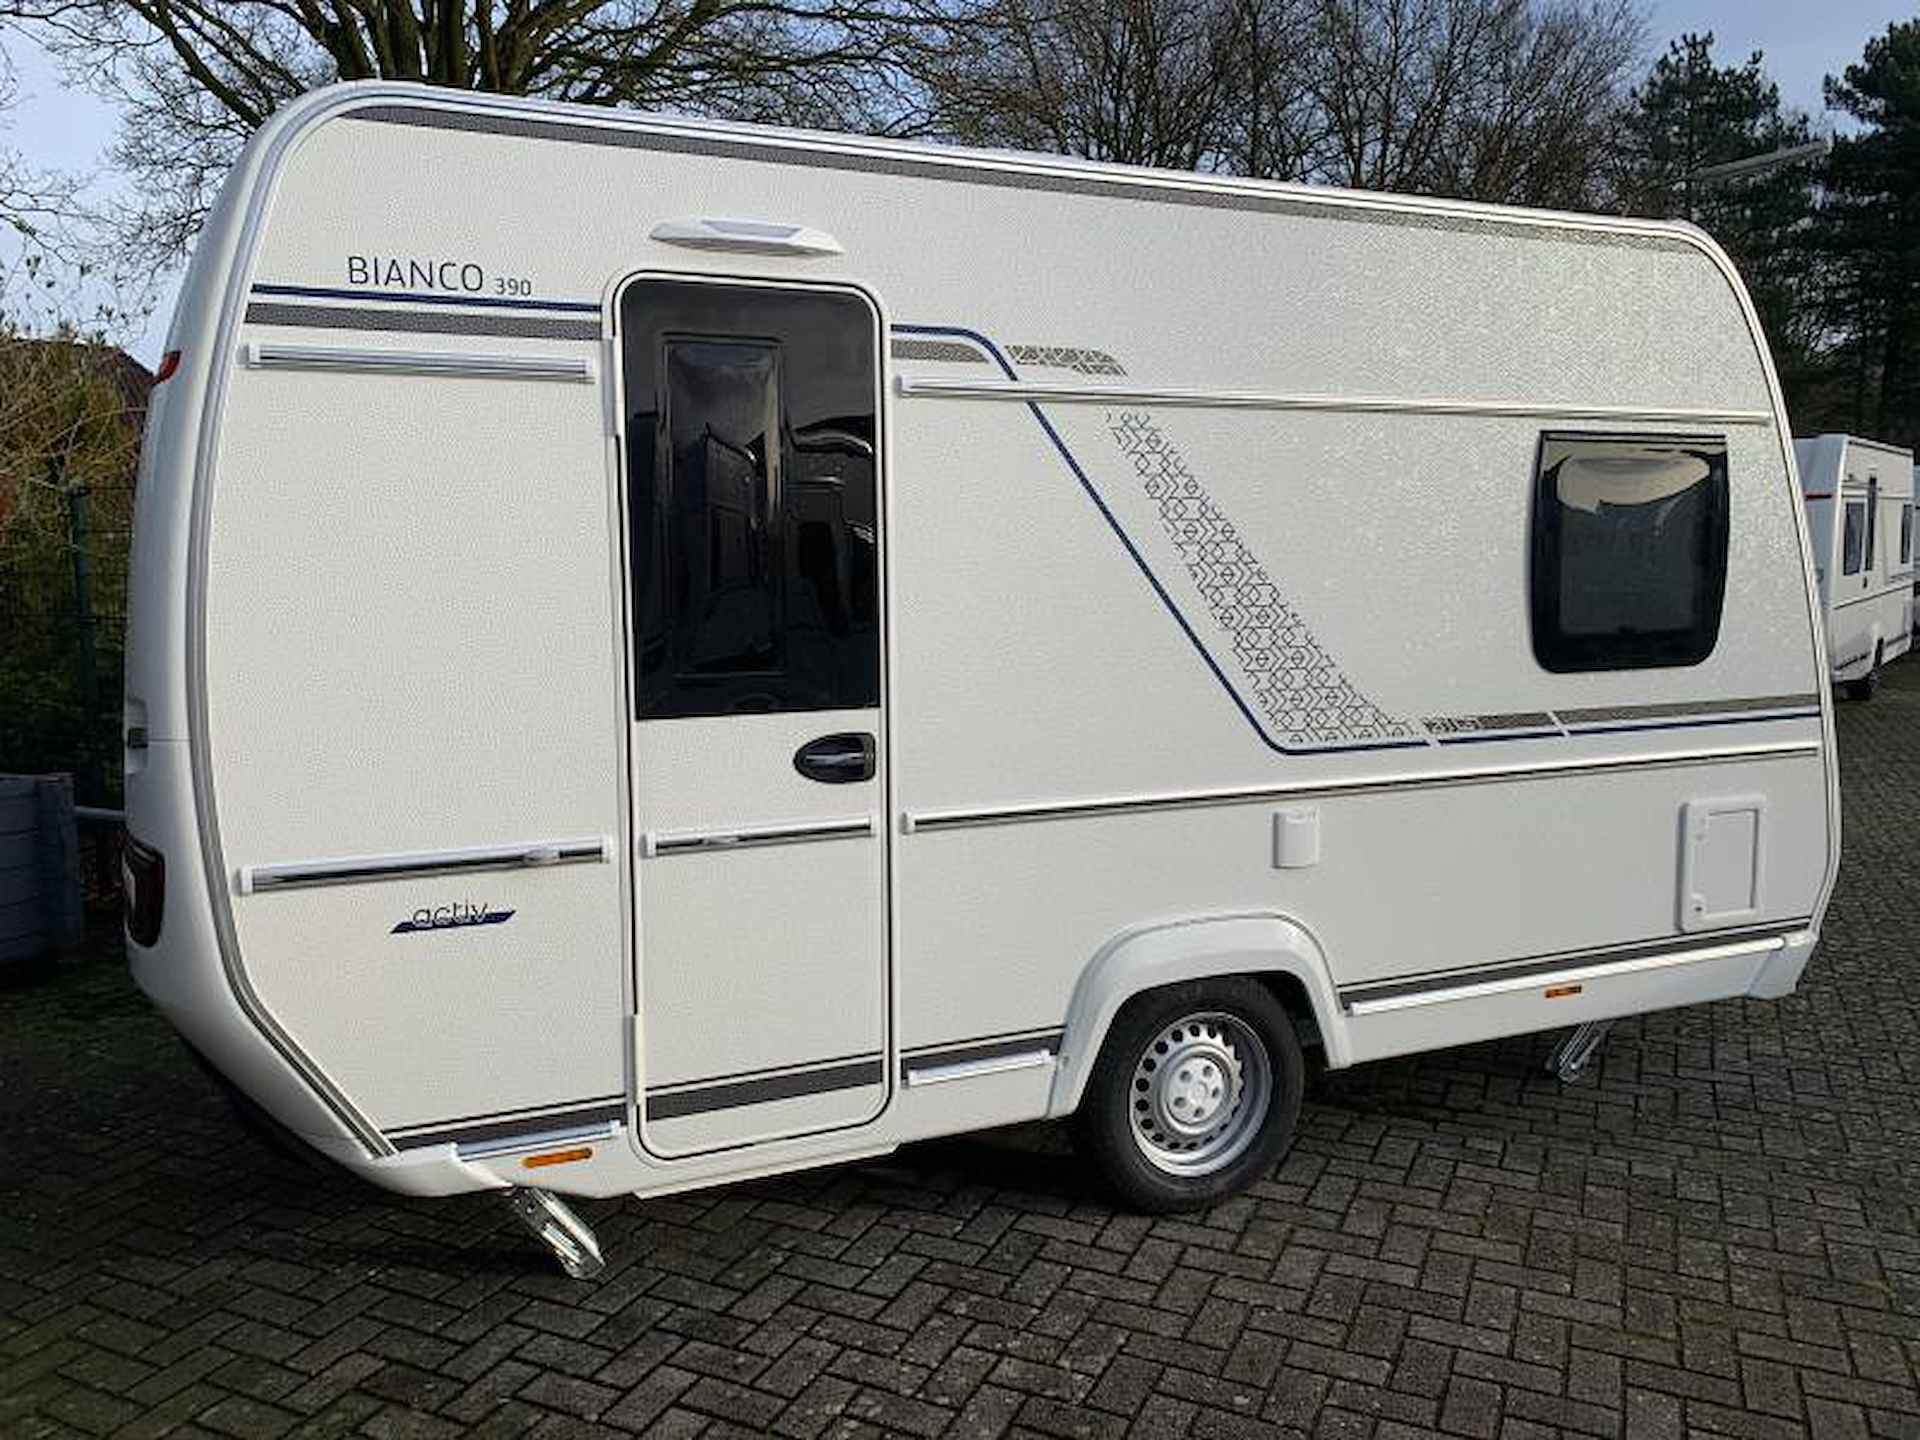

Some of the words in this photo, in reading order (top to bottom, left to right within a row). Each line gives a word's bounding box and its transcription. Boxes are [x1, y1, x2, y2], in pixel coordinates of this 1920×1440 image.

[348, 256, 484, 292] BIANCO
[495, 277, 532, 297] 390
[412, 899, 489, 928] activ
